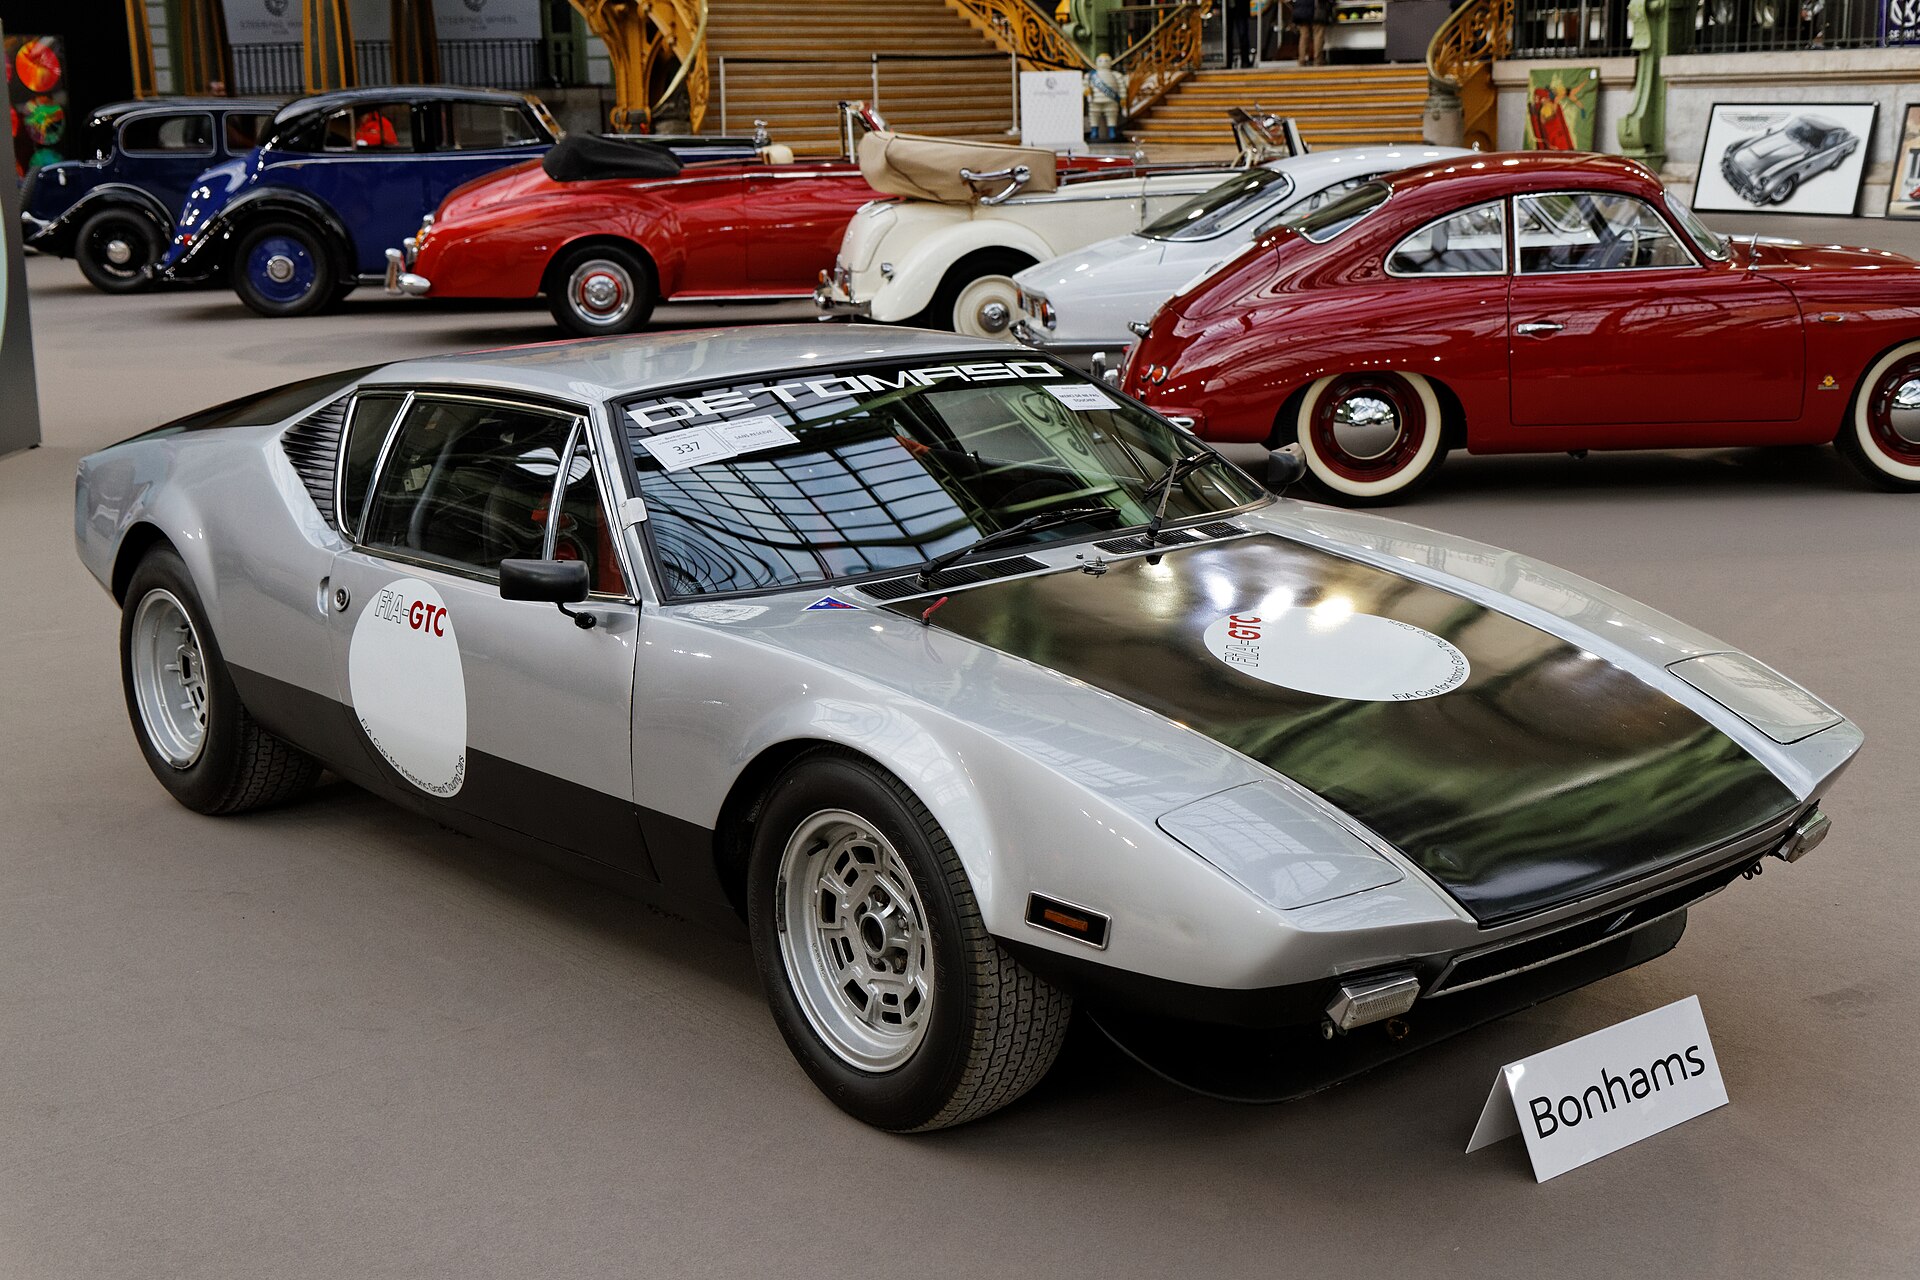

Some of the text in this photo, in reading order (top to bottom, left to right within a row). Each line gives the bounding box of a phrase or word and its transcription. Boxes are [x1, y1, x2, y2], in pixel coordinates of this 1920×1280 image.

[672, 441, 702, 455] 337
[1387, 619, 1416, 631] Cars
[1446, 666, 1465, 684] Historic
[1415, 687, 1440, 697] Cup
[1435, 681, 1451, 692] for
[373, 737, 390, 758] Cup
[389, 755, 400, 770] for
[400, 766, 429, 790] Historic
[427, 781, 449, 794] Grand
[445, 773, 464, 792] Touring
[455, 754, 466, 776] Cars
[1528, 1044, 1706, 1140] Bonhams
